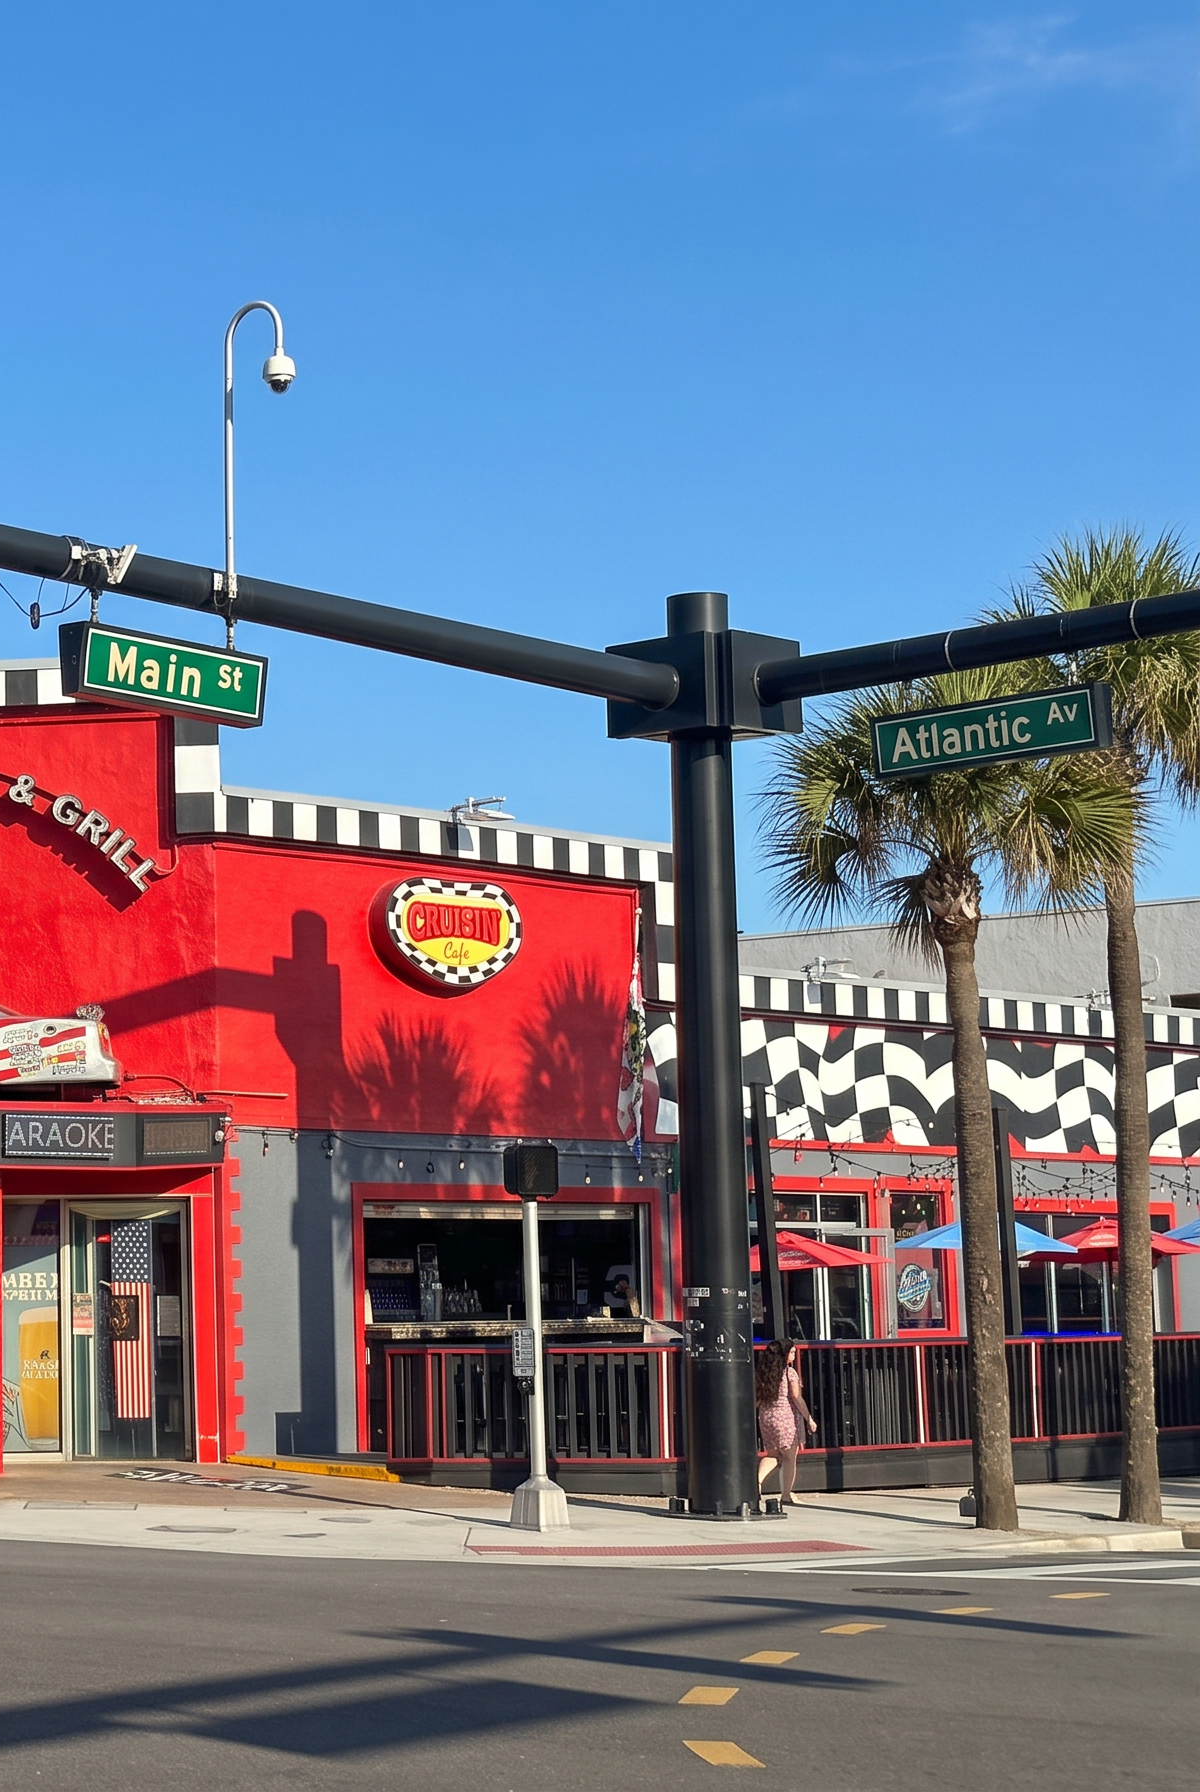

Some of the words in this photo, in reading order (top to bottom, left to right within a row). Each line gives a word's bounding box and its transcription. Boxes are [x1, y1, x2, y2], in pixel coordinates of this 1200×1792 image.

[107, 641, 201, 698] Main
[218, 664, 243, 692] St
[892, 711, 1032, 764] Atlantic
[1047, 701, 1078, 725] Av
[9, 774, 36, 807] &
[52, 794, 156, 893] GRILL
[443, 941, 469, 965] Cafe
[8, 1121, 114, 1149] ARAOKE
